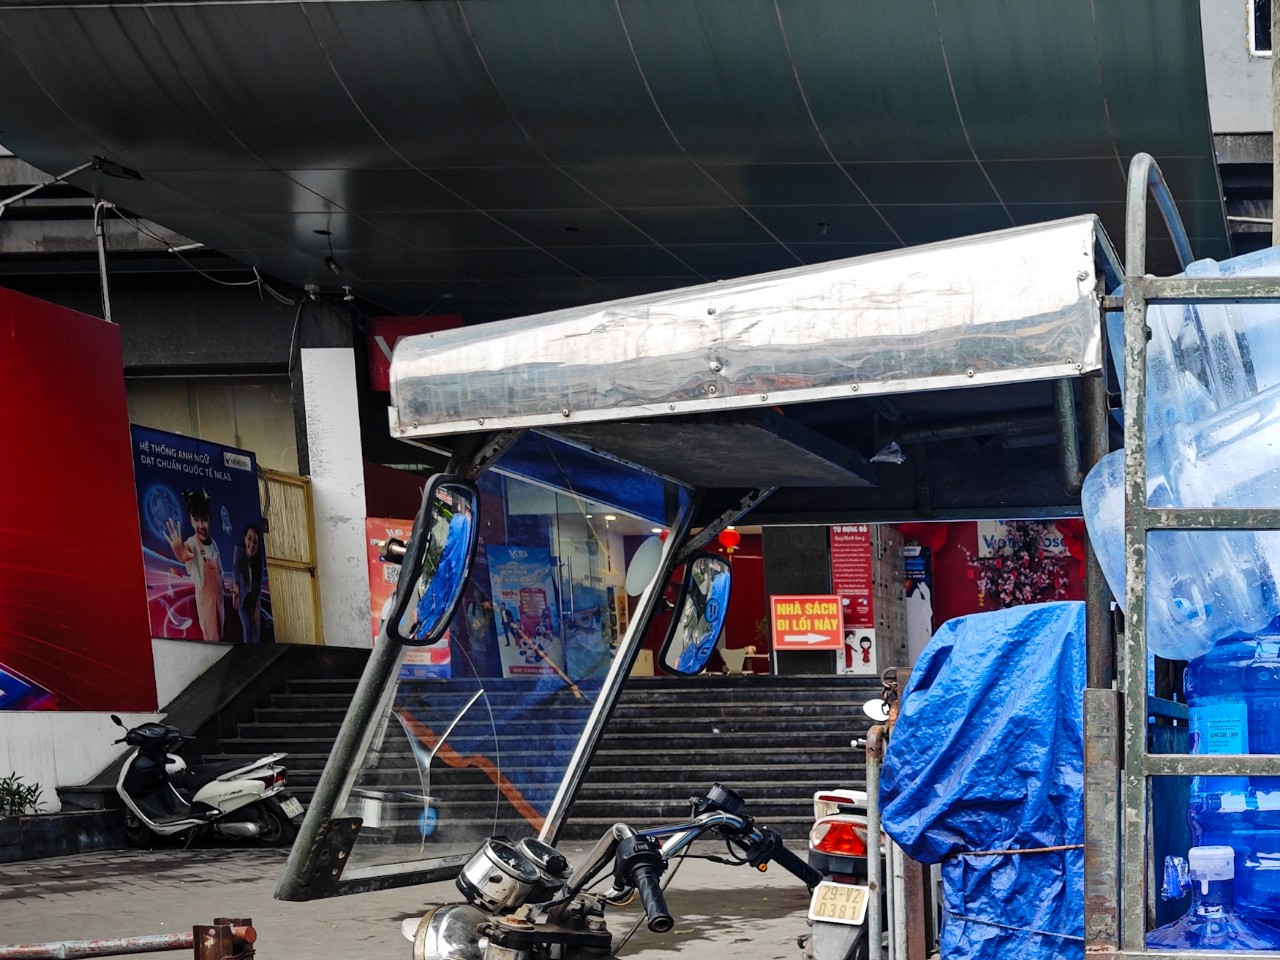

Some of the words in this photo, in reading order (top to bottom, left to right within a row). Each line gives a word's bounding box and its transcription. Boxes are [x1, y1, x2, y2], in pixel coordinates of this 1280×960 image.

[140, 441, 149, 454] HỆ
[151, 444, 177, 457] THỐNG
[178, 450, 193, 462] ANH
[194, 453, 210, 464] NGỮ
[141, 455, 155, 467] ĐẠT
[156, 458, 181, 472] CHUẨN
[183, 463, 204, 476] QUỐC
[205, 467, 214, 478] TẾ
[214, 471, 232, 481] NEAS
[777, 601, 802, 615] NHÀ
[805, 601, 837, 615] SÁCH
[777, 619, 789, 631] ĐI
[792, 616, 811, 631] LỐI
[814, 617, 838, 631] NÀY
[821, 886, 861, 903] 29-V2
[819, 902, 857, 920] 0381
